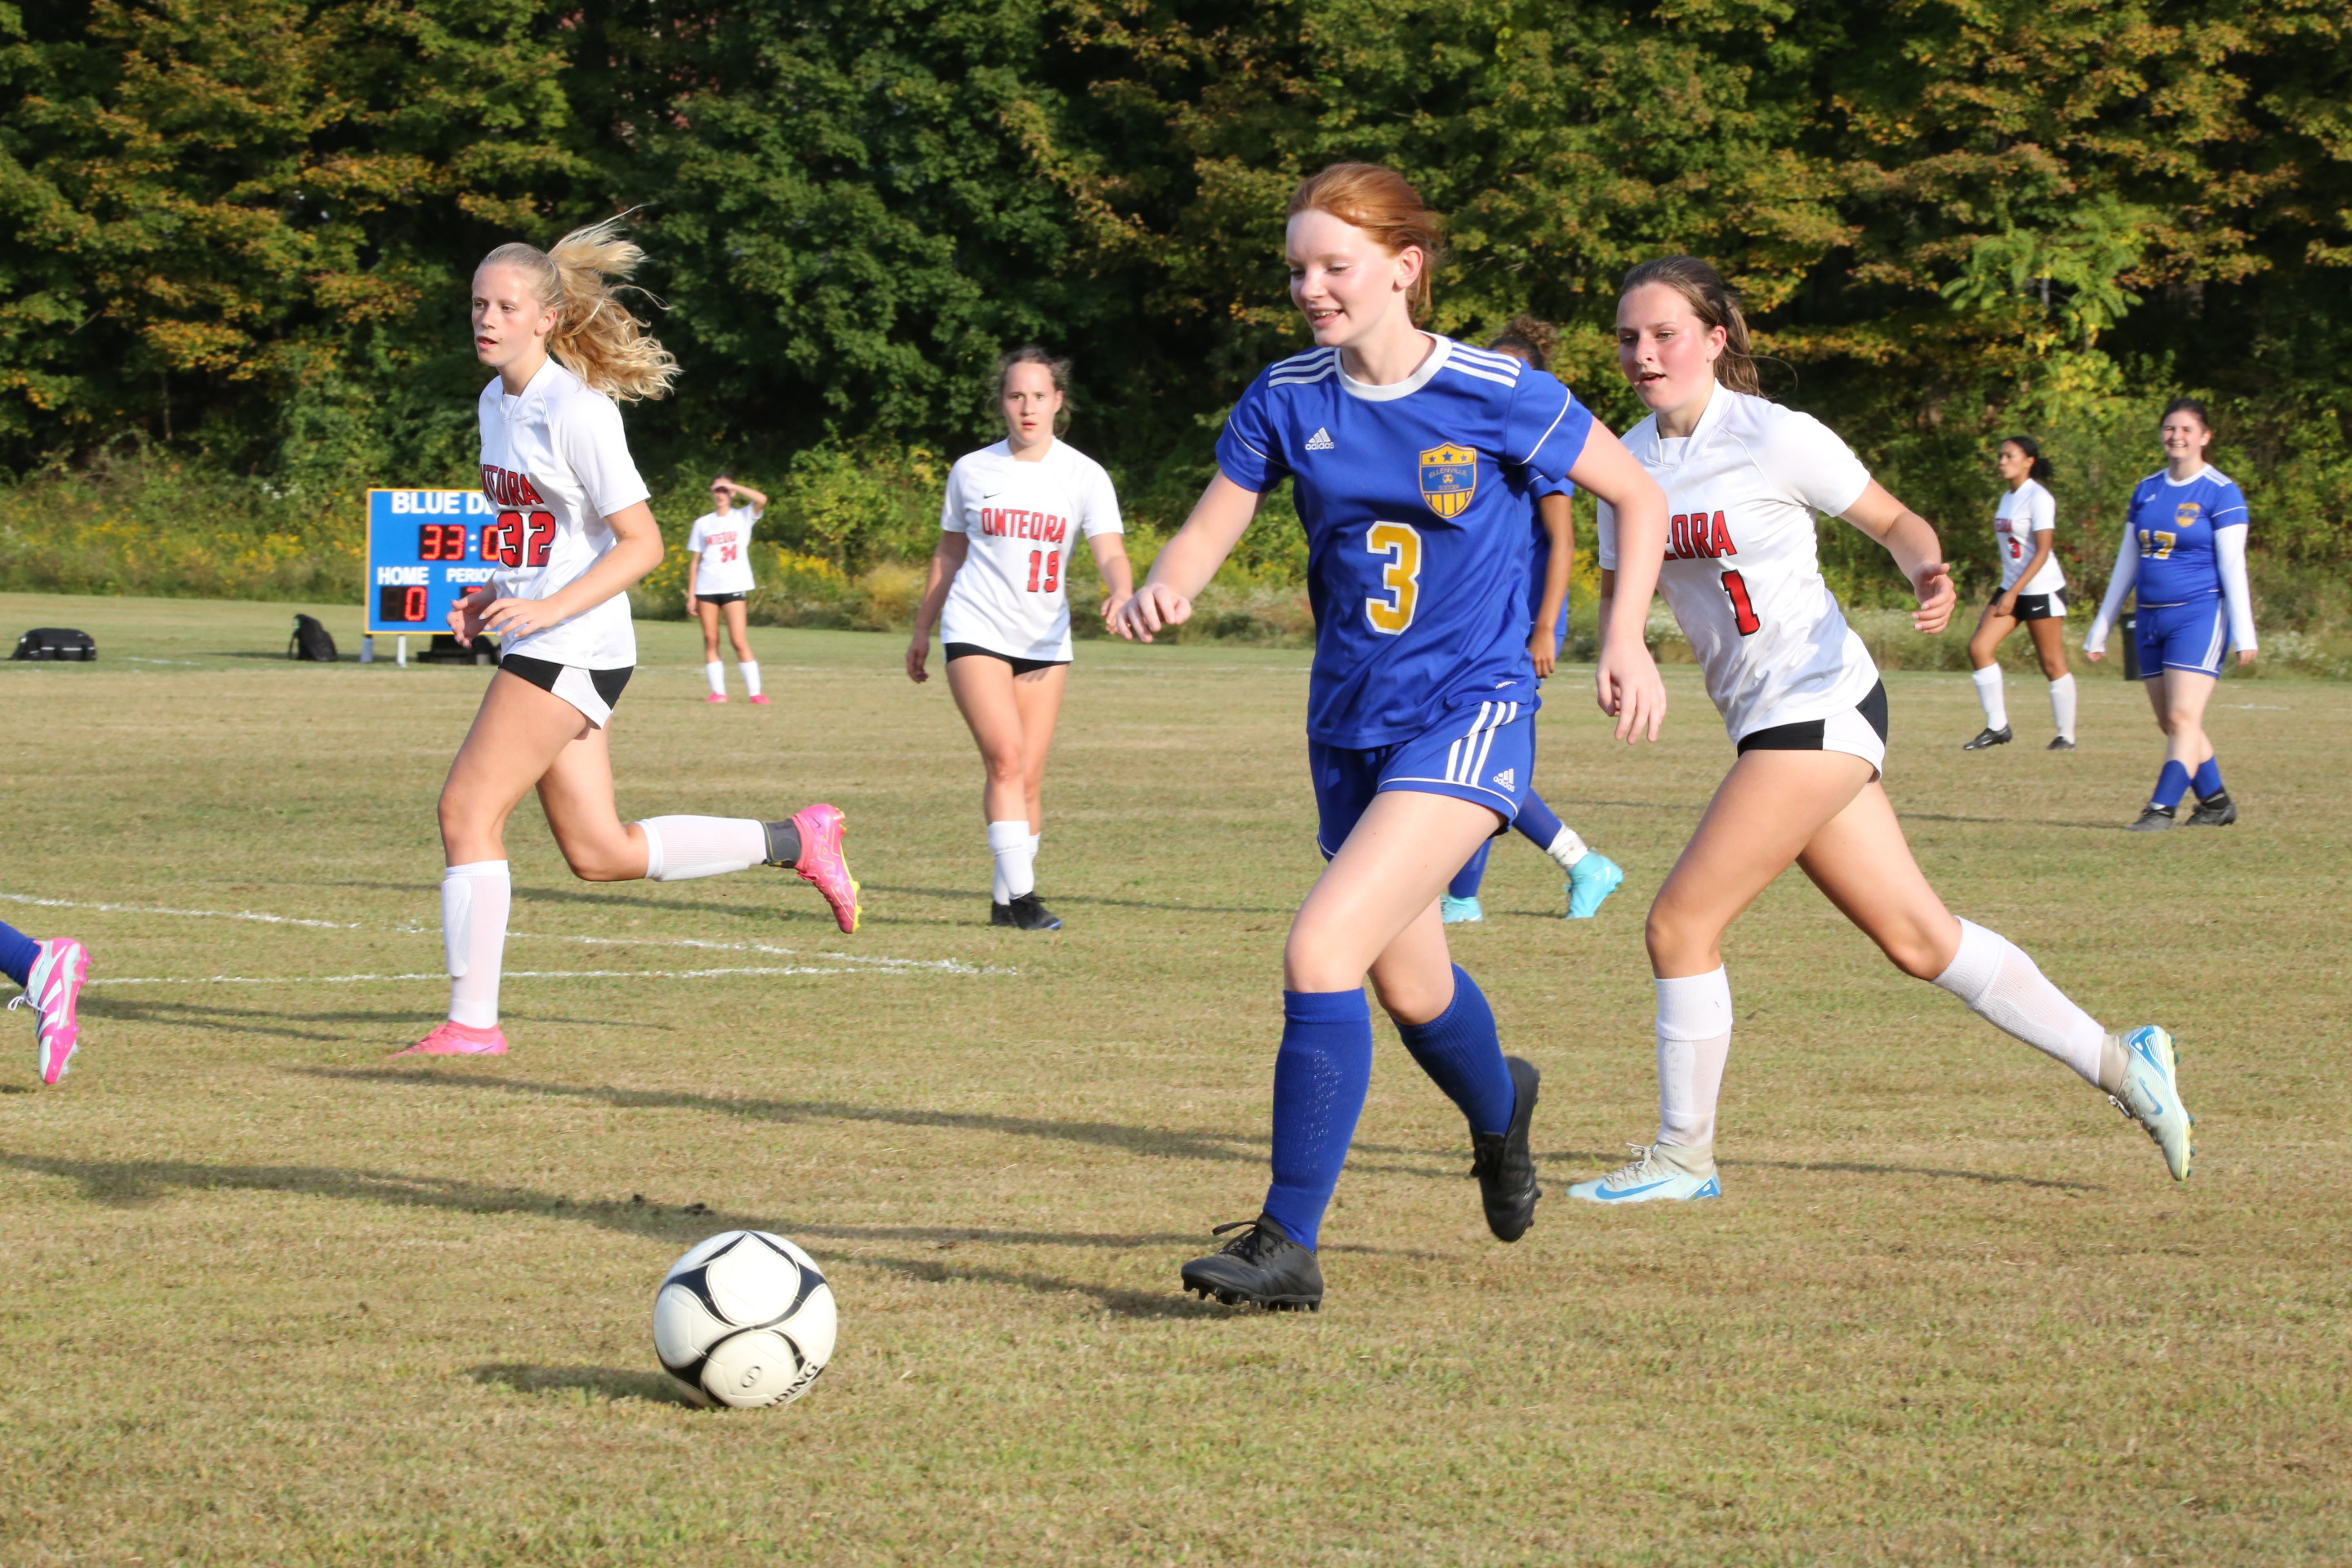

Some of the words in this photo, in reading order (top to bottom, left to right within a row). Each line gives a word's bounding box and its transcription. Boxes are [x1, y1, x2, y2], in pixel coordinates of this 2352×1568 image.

[1305, 441, 1334, 450] adidas
[391, 492, 461, 514] BLUE
[497, 510, 556, 568] 32
[982, 507, 1066, 544] ONTEORA
[2007, 536, 2021, 559] 3
[2139, 529, 2176, 559] 17
[377, 567, 430, 585] HOME
[446, 567, 496, 582] PERIO
[1027, 550, 1059, 593] 19
[1366, 521, 1422, 635] 3
[404, 586, 428, 621] 0
[1721, 569, 1761, 636] 1
[1493, 776, 1515, 792] adidas
